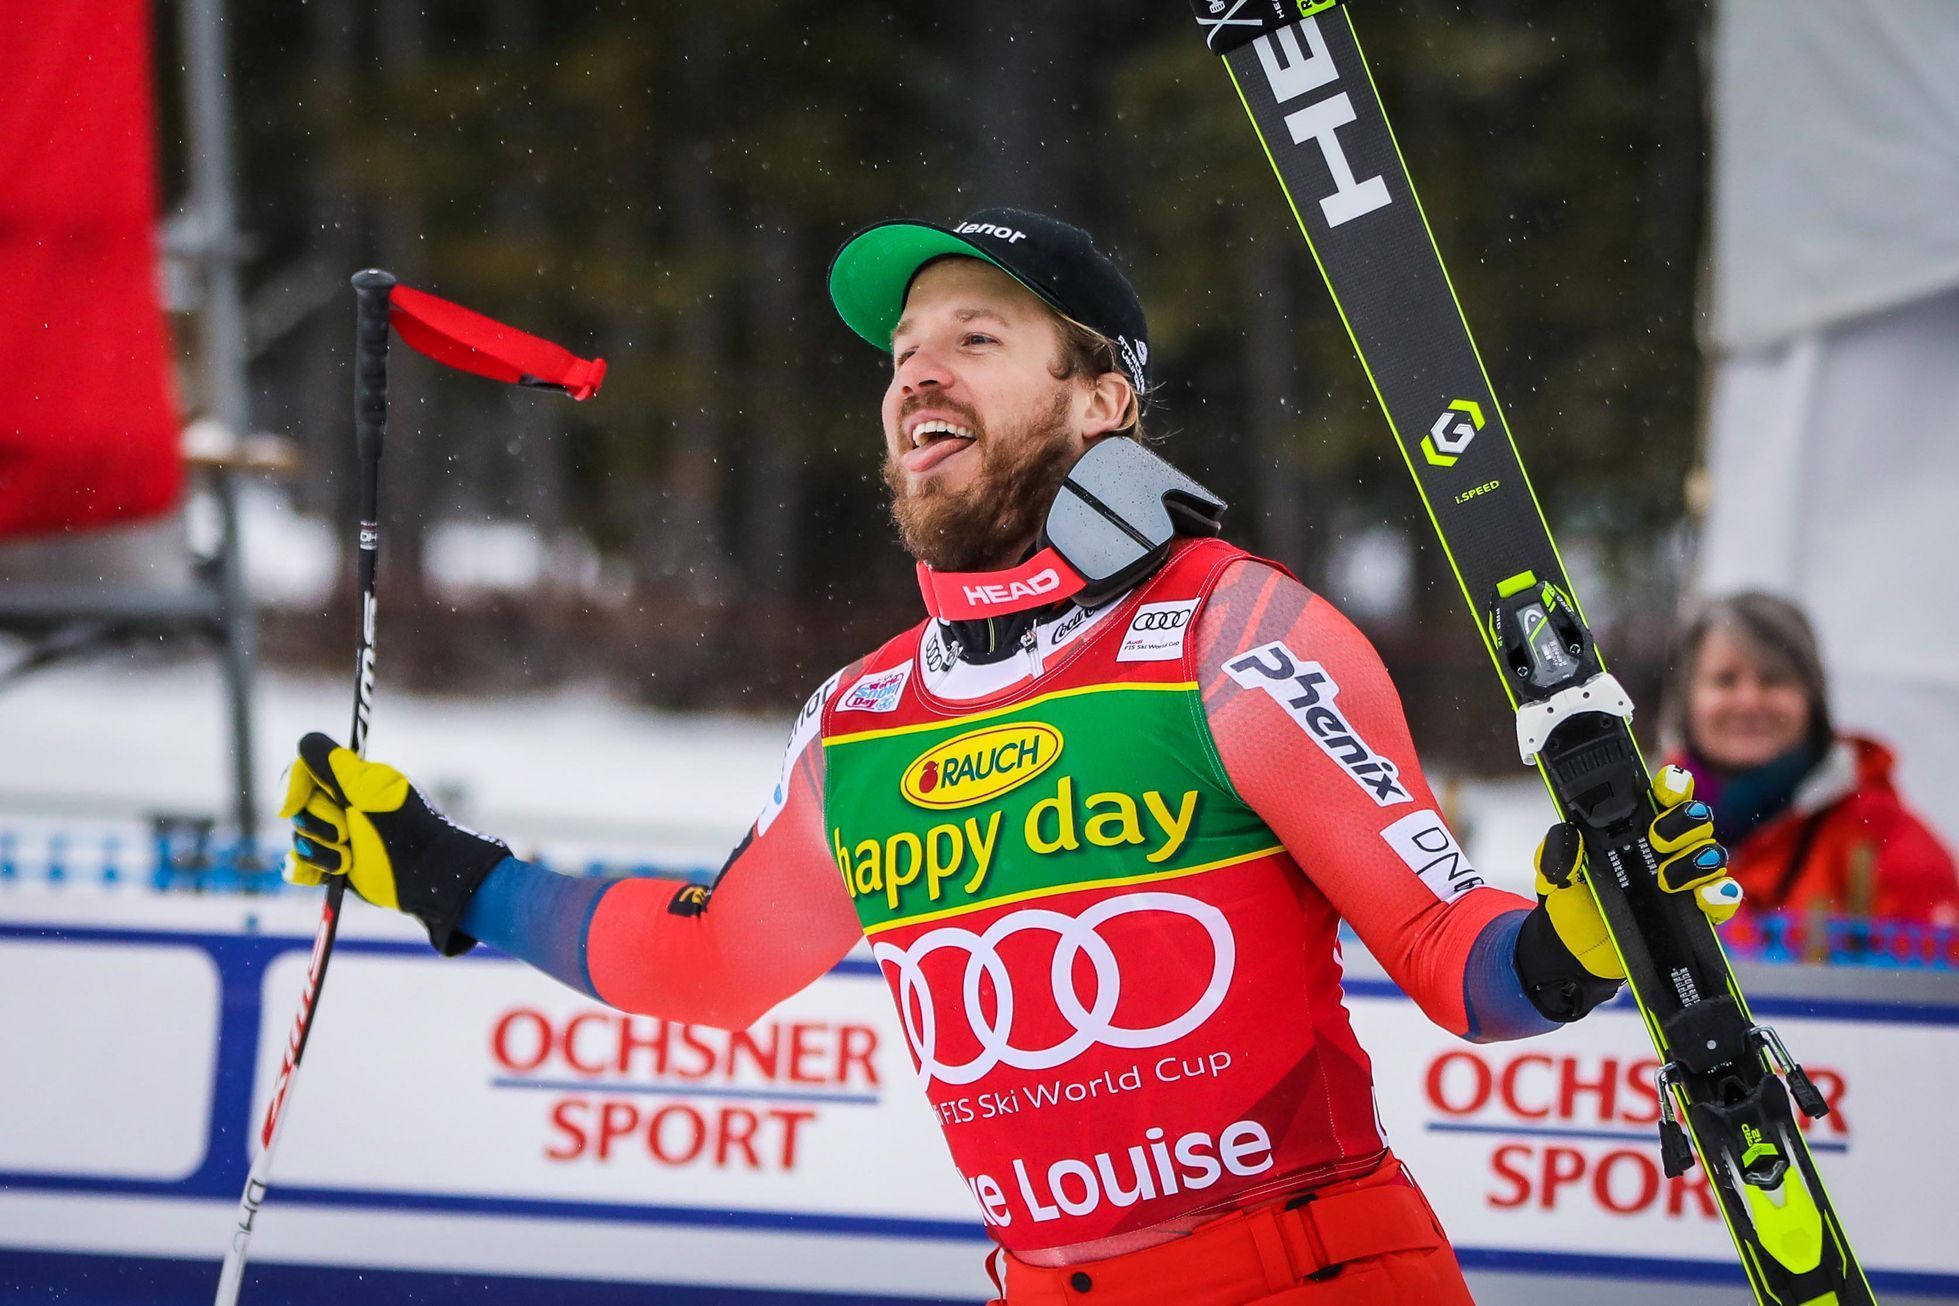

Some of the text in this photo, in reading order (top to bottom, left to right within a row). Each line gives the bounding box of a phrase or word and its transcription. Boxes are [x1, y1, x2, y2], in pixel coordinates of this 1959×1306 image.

[1252, 16, 1393, 228] HE
[962, 568, 1060, 607] HEAD
[941, 735, 1039, 789] RAUCH
[1230, 646, 1407, 801] Phenix
[1024, 775, 1199, 864] day
[834, 810, 1002, 910] happy
[490, 1007, 882, 1086] OCHSNER
[940, 1098, 975, 1125] FIS
[977, 1089, 1020, 1119] Ski
[1022, 1065, 1142, 1109] World
[1154, 1050, 1233, 1082] Cup
[545, 1097, 816, 1172] SPORT
[1012, 1119, 1275, 1223] Louise
[1486, 1142, 1720, 1221] SPOR
